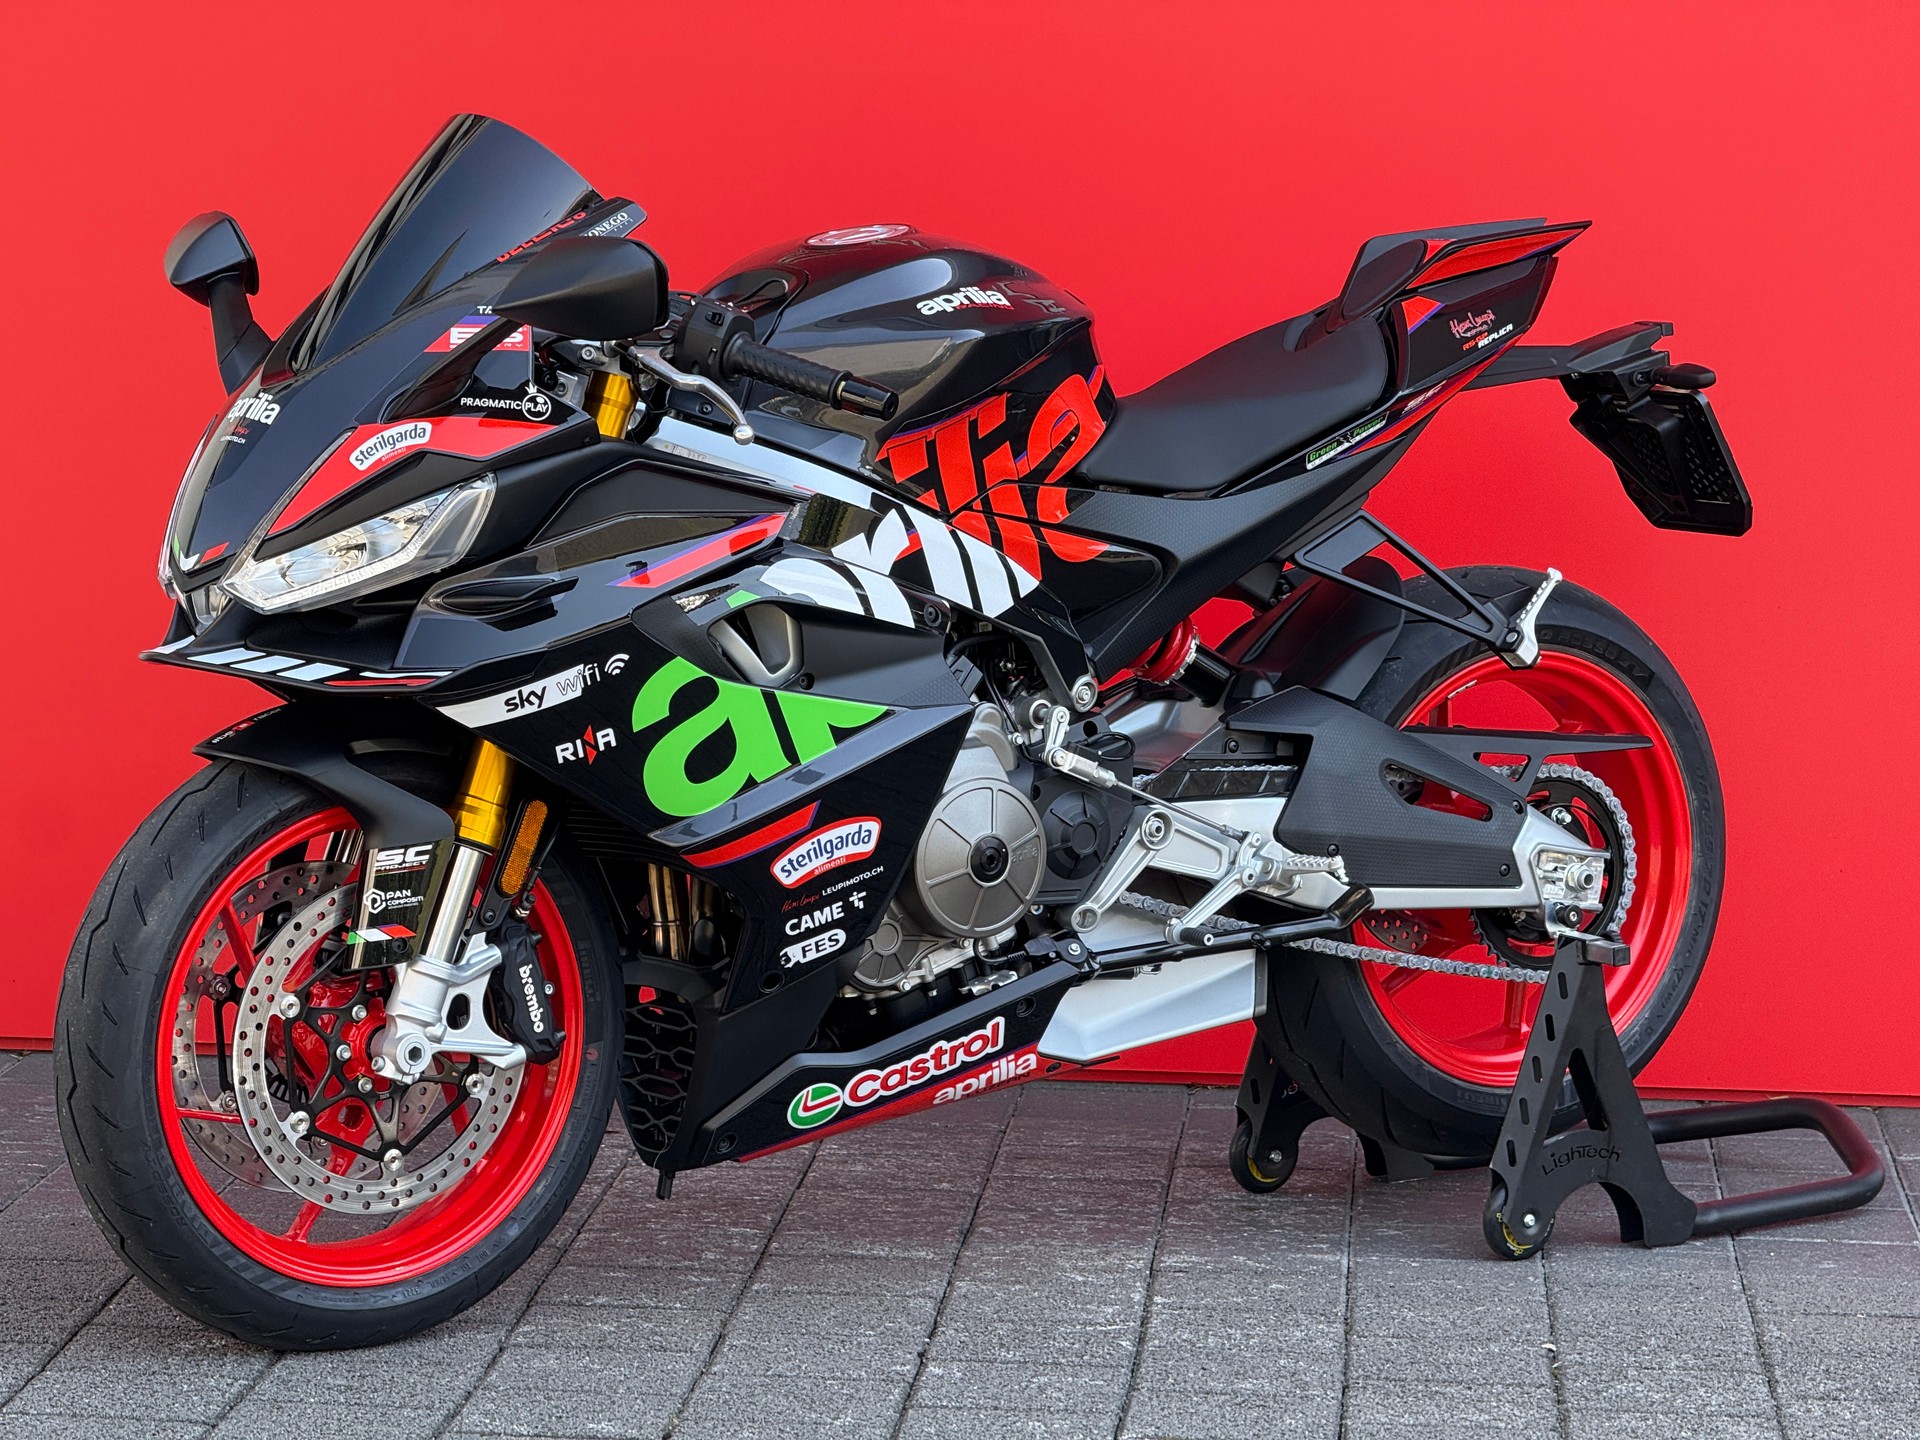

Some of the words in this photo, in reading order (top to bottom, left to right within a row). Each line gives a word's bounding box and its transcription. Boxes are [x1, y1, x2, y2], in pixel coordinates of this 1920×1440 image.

[584, 212, 628, 237] ONEGO
[916, 287, 1009, 316] aprilia
[1478, 323, 1513, 348] REPLICA
[227, 392, 280, 425] aprilia
[460, 397, 521, 411] PRAGMATIC
[524, 401, 549, 413] PLAY
[354, 423, 427, 466] sterilgarda
[1309, 441, 1338, 461] Green
[1353, 416, 1384, 437] Power
[381, 447, 407, 462] alimenti
[503, 684, 547, 714] sky
[556, 662, 601, 696] wifi
[374, 844, 433, 867] SC
[780, 824, 872, 878] sterilgarda
[813, 856, 847, 876] alimenti
[386, 889, 411, 900] PAN
[822, 865, 885, 896] LEUPIMOTO.CH
[785, 901, 845, 936] CAME
[800, 933, 841, 959] FES
[518, 964, 544, 1033] brembo
[847, 1020, 1001, 1104] Castrol
[932, 1052, 1038, 1105] aprilia
[1542, 1144, 1621, 1176] LighTech
